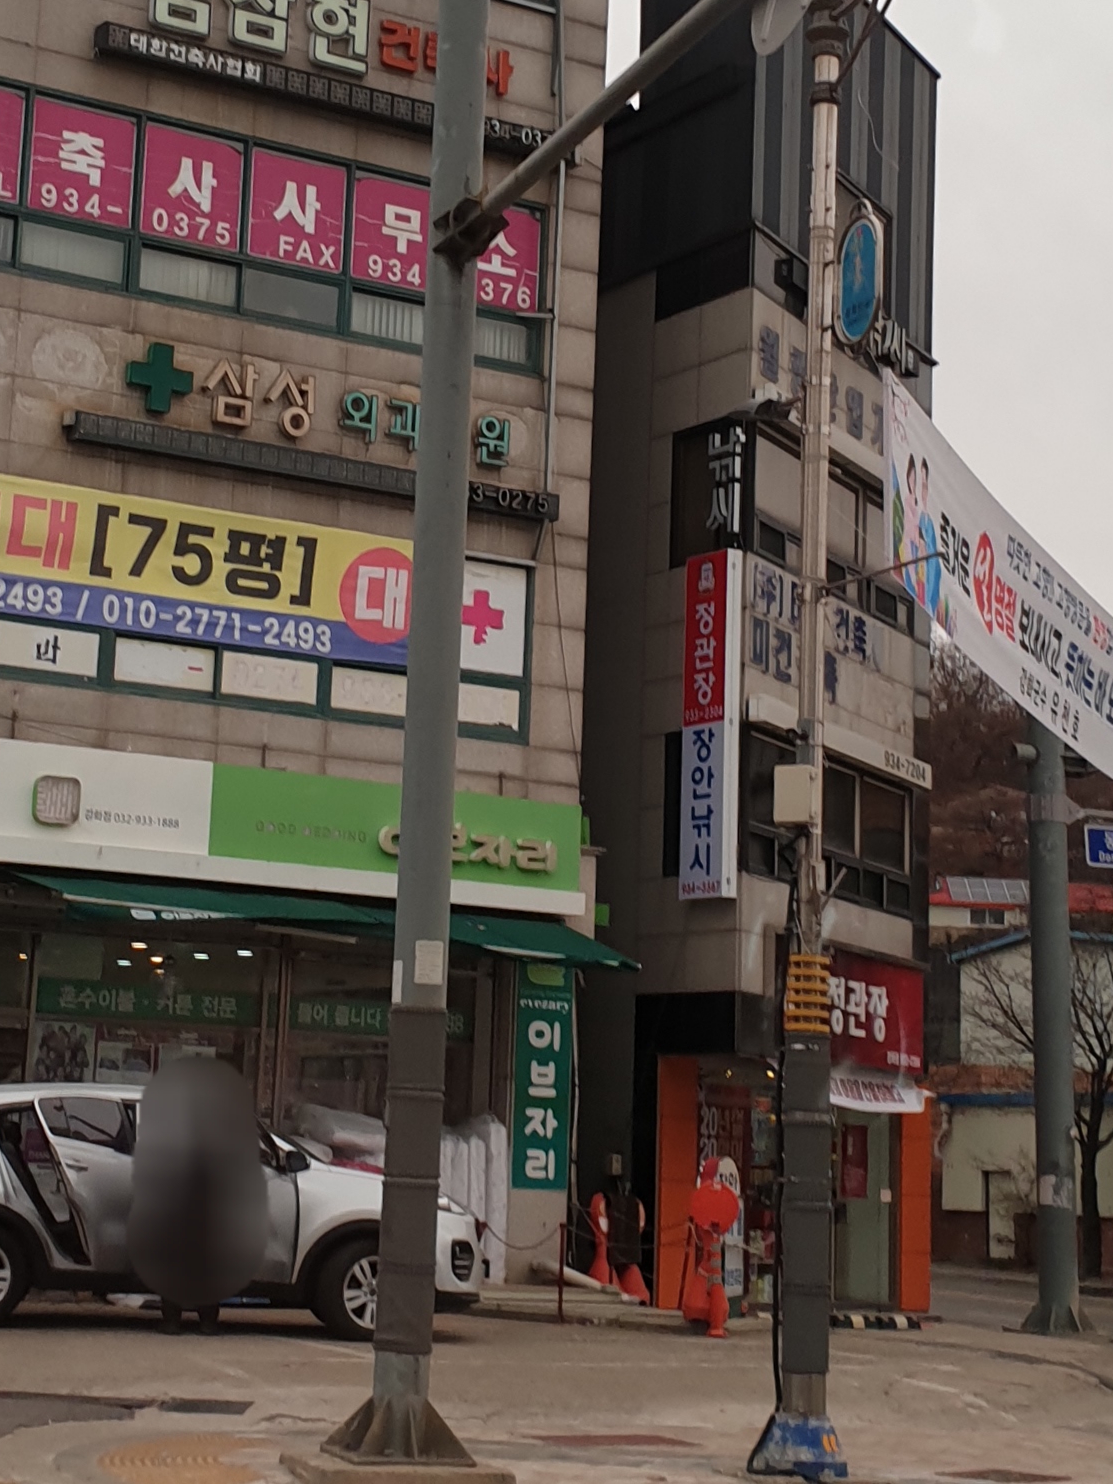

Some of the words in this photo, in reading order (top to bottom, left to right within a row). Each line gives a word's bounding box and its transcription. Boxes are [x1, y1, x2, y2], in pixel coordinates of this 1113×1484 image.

[129, 32, 262, 83] 대한건축사협회
[380, 19, 515, 96] 건사
[40, 182, 231, 247] 934-0375
[278, 234, 337, 270] FAX
[202, 357, 316, 438] 삼성
[340, 390, 511, 467] 외과원
[88, 501, 319, 608] [75평]
[102, 594, 333, 654] 010-2771-2493
[354, 565, 406, 630] 대
[939, 511, 971, 599] 즐거운
[994, 575, 1017, 644] 명절
[1064, 641, 1095, 709] 뜻하는
[693, 600, 717, 706] 정관장
[689, 727, 715, 877] 장안낚시
[884, 749, 926, 783] 934-7204
[201, 993, 238, 1019] 전문
[827, 975, 889, 1044] 정관장
[526, 1019, 562, 1183] 이브자리
